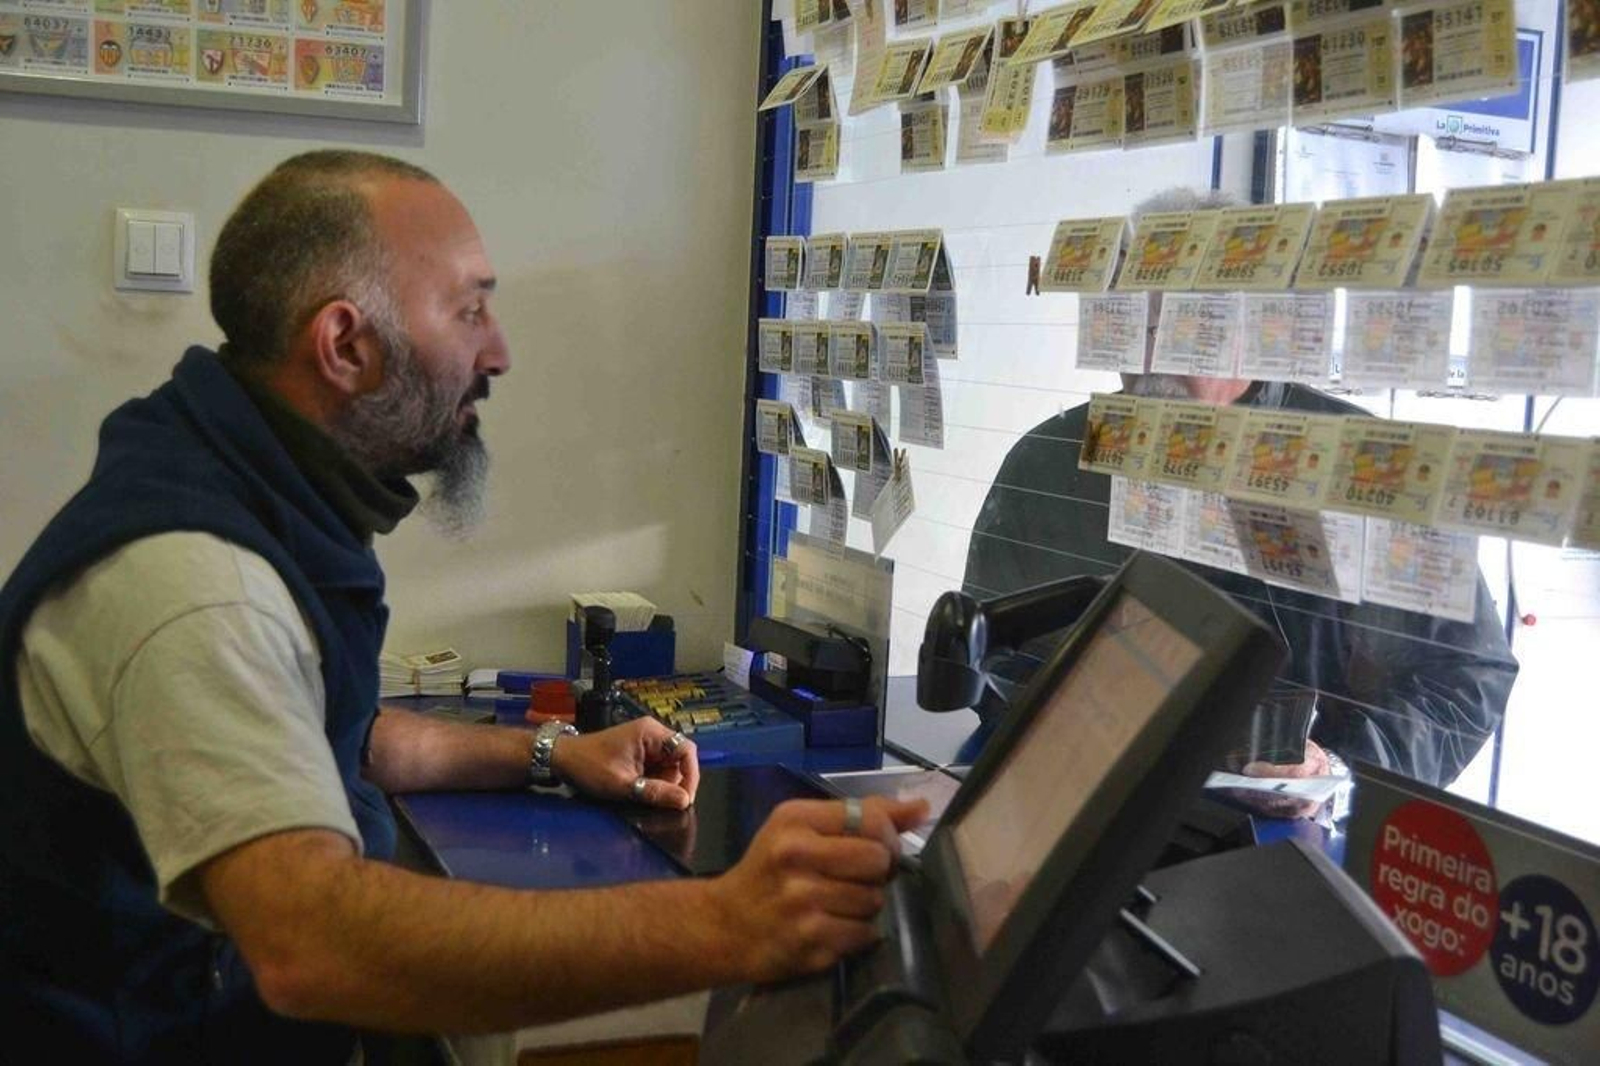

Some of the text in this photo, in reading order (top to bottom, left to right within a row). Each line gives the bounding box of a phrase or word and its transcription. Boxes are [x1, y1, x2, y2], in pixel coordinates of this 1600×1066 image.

[1464, 123, 1500, 136] Primitiva
[1383, 824, 1493, 894] Primeira
[1378, 863, 1489, 928] regra do
[1392, 904, 1466, 956] xogo:
[1500, 901, 1587, 974] +18
[1500, 952, 1575, 1006] anos
